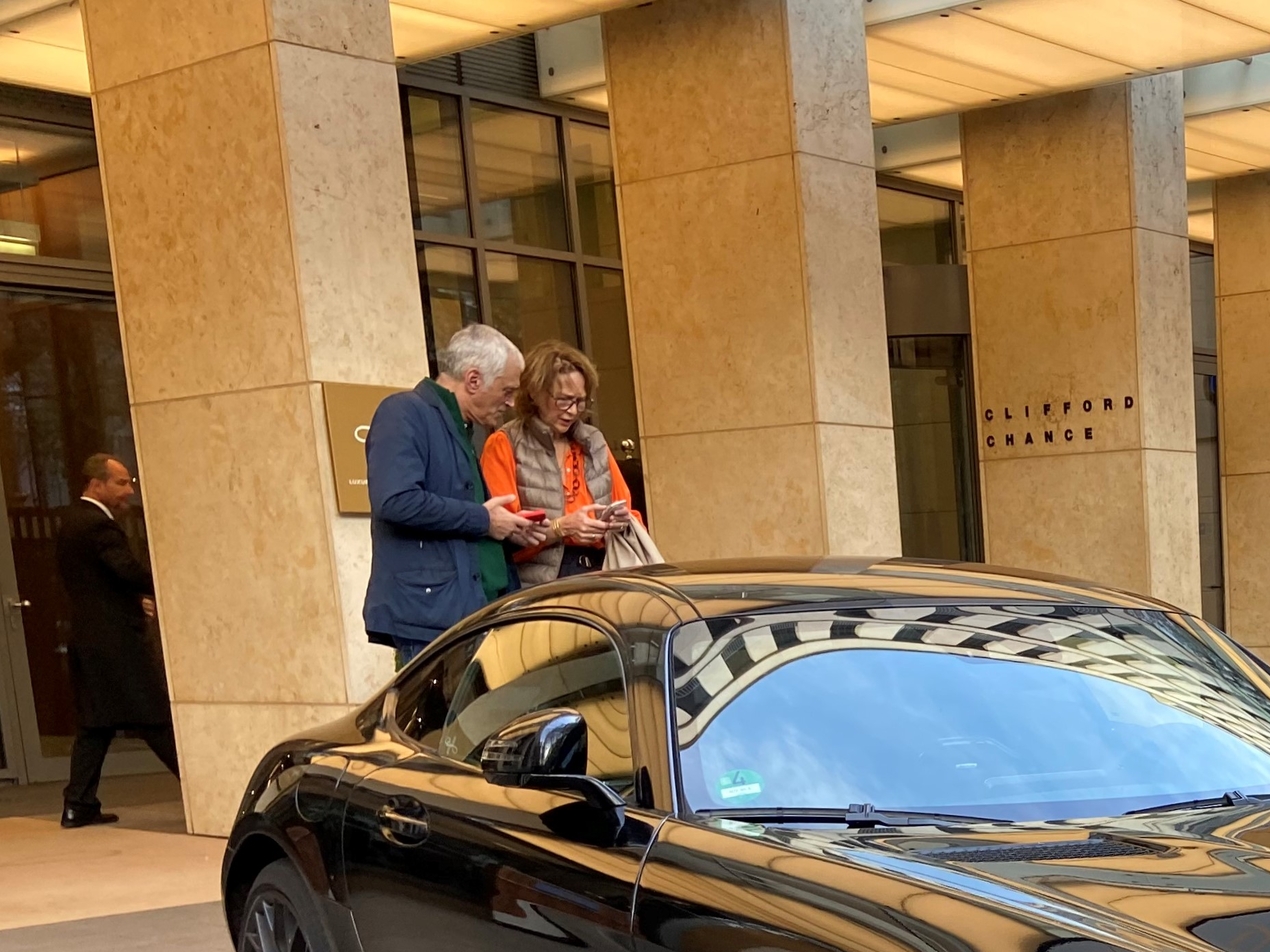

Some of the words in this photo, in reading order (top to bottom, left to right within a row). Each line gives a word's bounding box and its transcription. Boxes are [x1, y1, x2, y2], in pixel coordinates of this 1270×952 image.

[985, 396, 1134, 421] CLIFFORD
[986, 427, 1093, 448] CHANCE
[732, 770, 746, 785] 4
